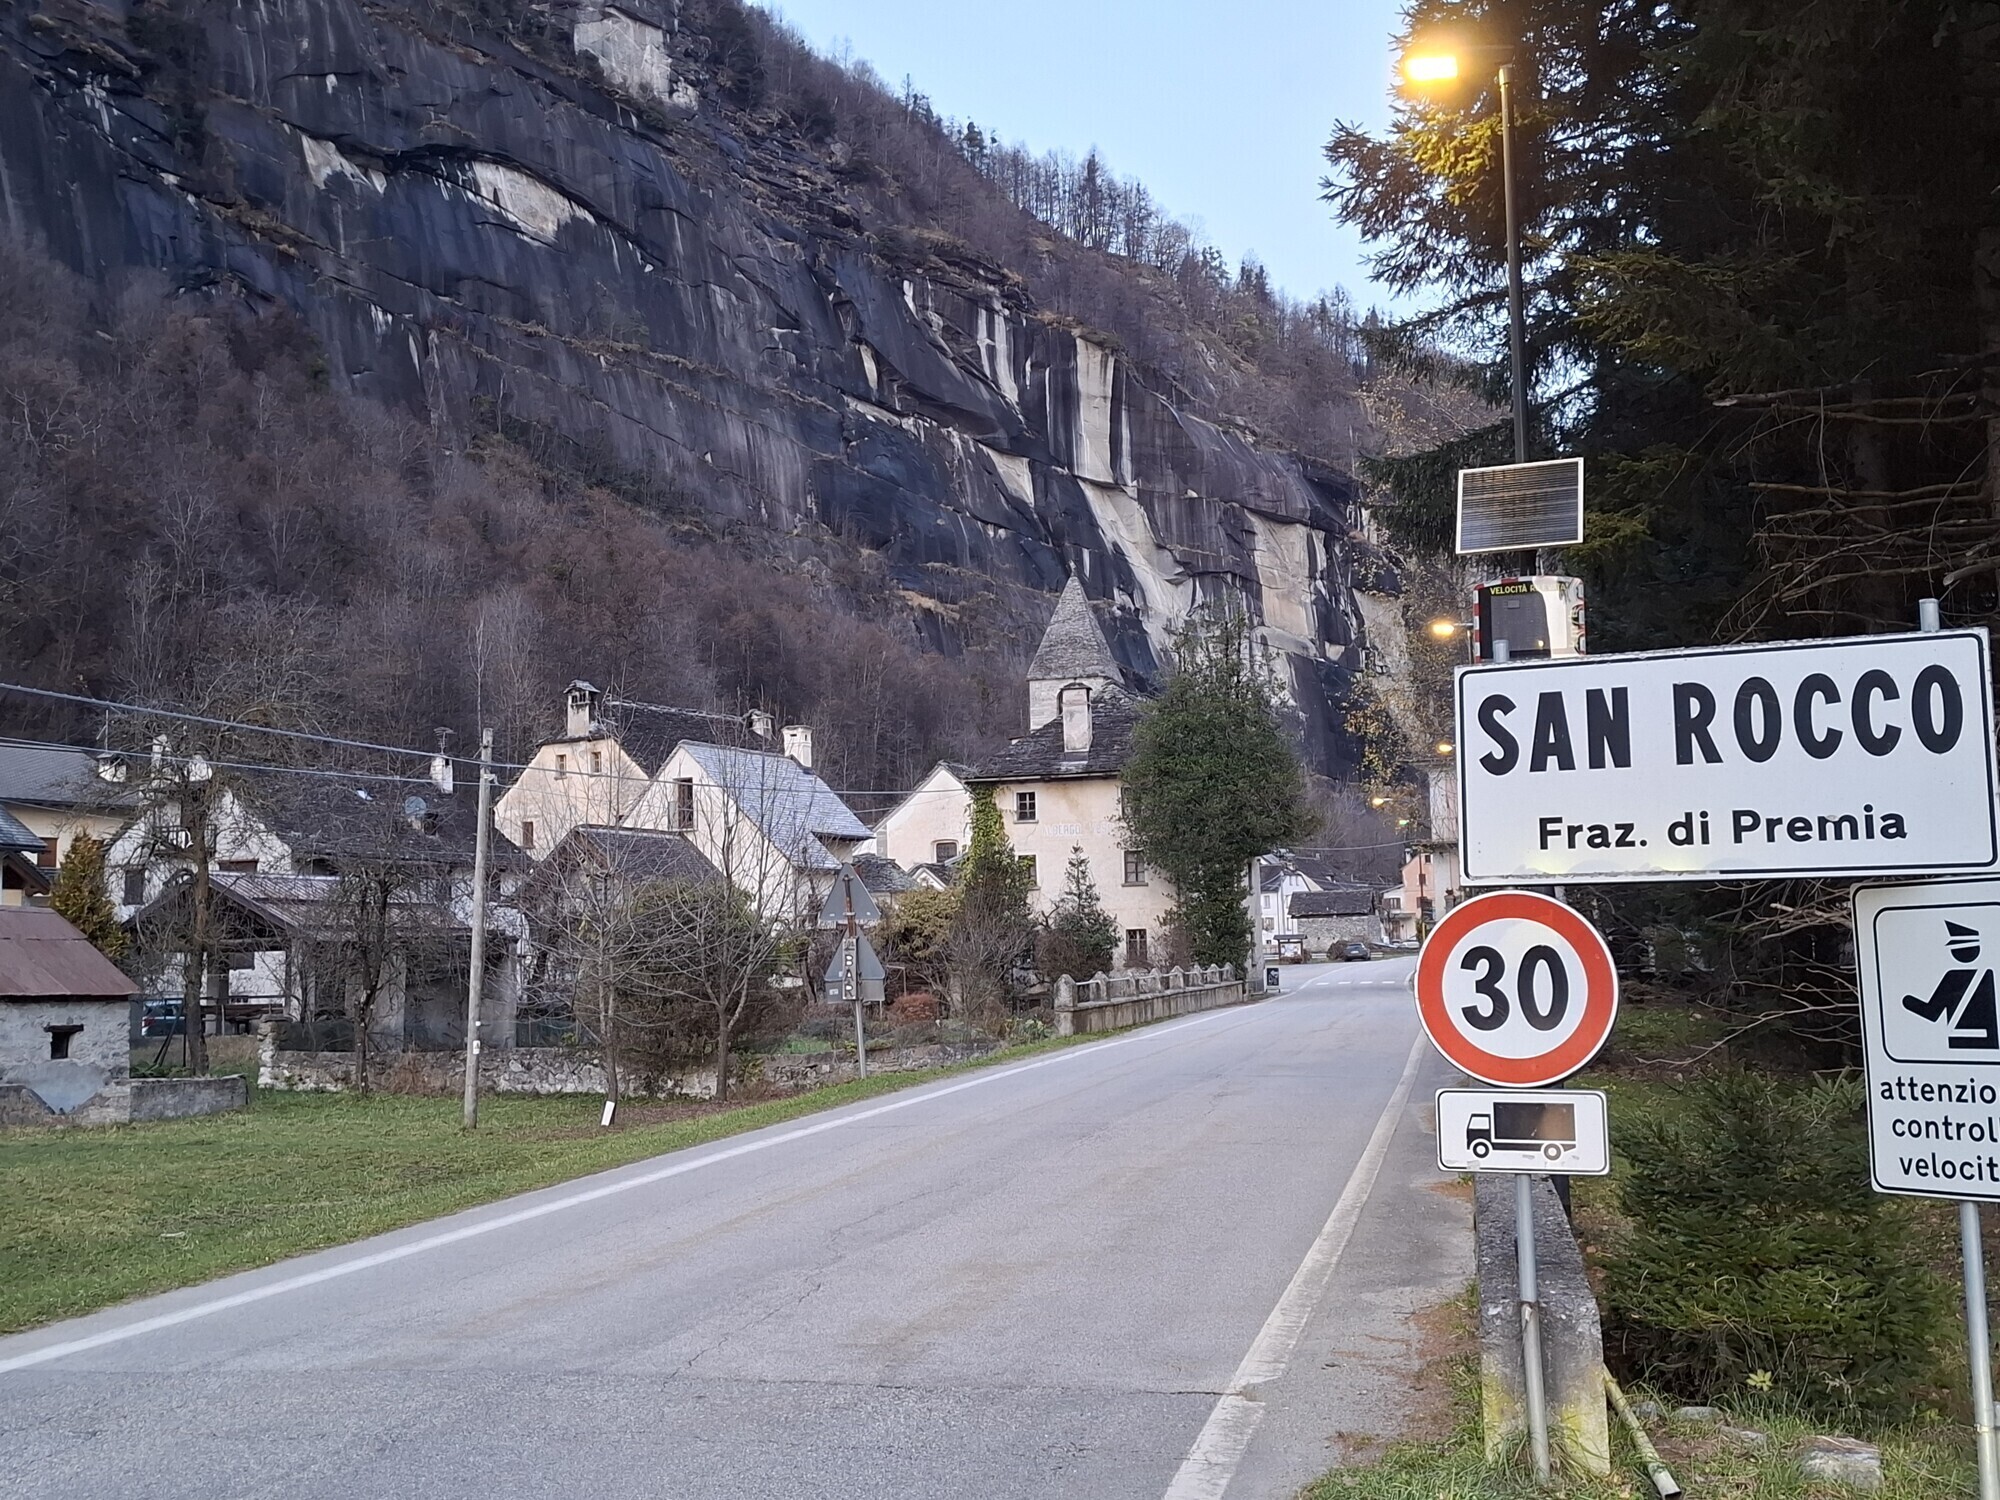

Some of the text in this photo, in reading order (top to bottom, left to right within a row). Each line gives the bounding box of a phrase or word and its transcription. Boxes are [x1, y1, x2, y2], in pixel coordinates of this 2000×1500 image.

[1478, 664, 1963, 776] SAN ROCCO
[1539, 804, 1908, 850] Fraz. di Premia
[844, 954, 854, 997] BAR
[1461, 945, 1569, 1031] 30
[1880, 1076, 1997, 1104] attenzio
[1892, 1115, 2000, 1143] control
[1899, 1152, 2000, 1182] velocit
